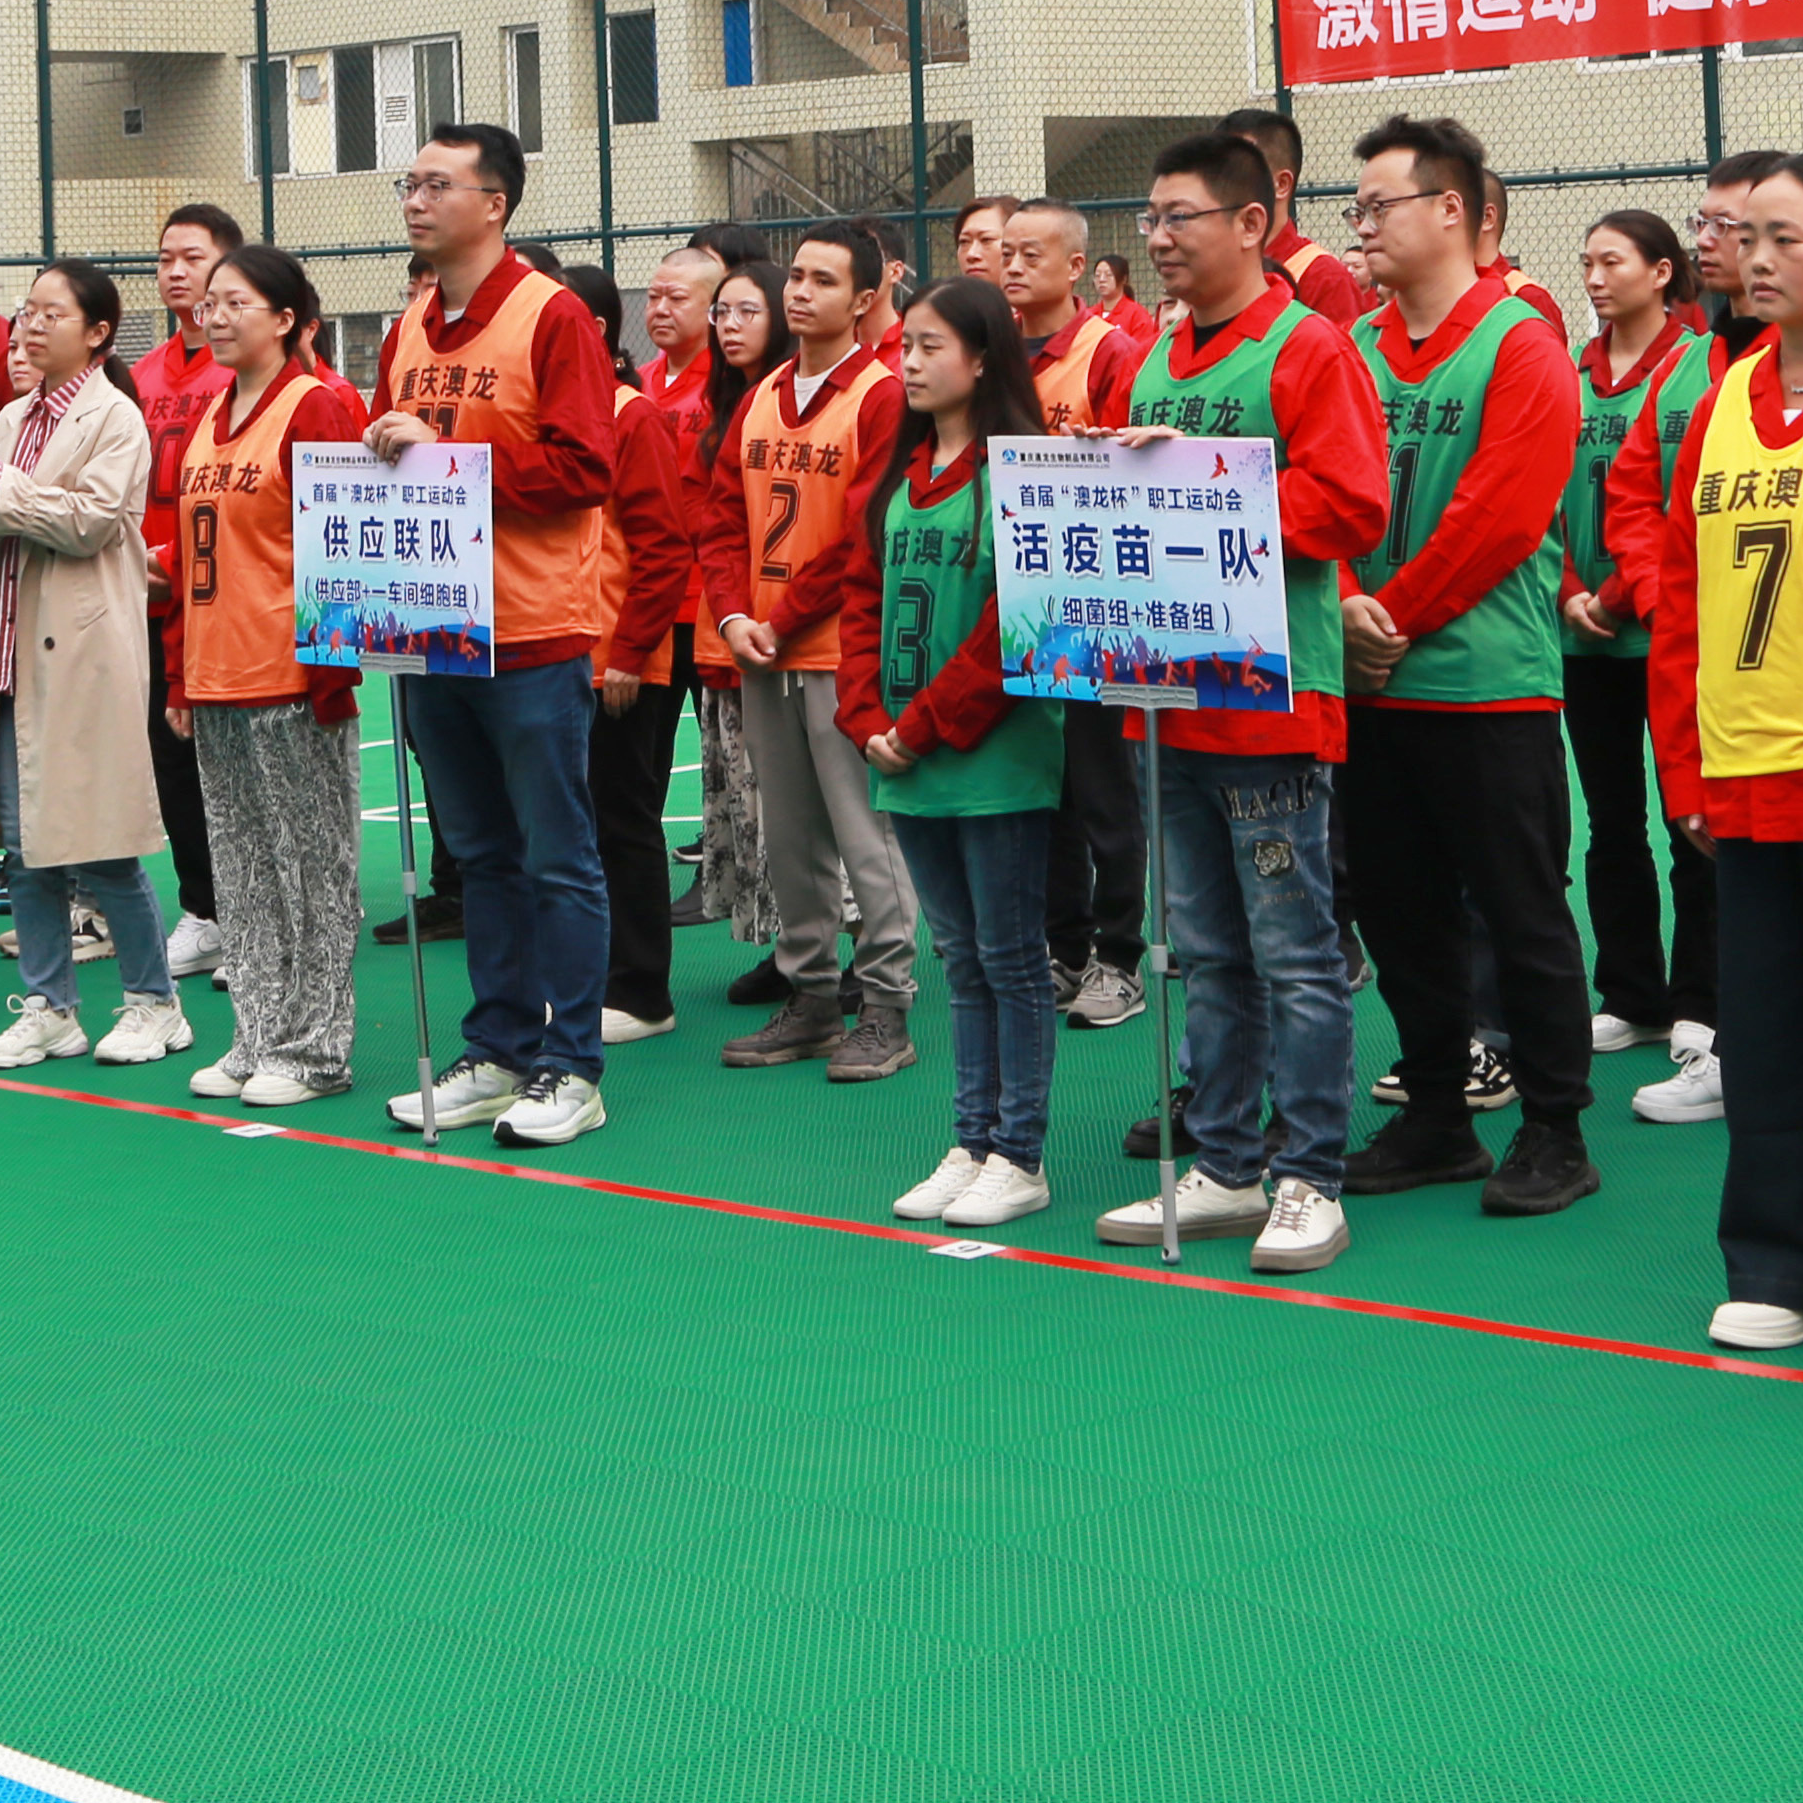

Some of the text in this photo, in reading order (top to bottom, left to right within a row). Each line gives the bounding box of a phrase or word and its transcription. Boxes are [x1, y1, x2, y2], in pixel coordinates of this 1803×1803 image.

[398, 363, 499, 403] 重庆澳龙
[180, 460, 262, 497] 重庆澳龙
[746, 438, 843, 477] 重庆澳龙
[313, 484, 467, 506] 首届“澳龙杯”职工运动会
[1019, 484, 1242, 511] 首届“澳龙杯”职工运动会
[190, 500, 219, 606] 8
[323, 515, 457, 562] 供应联队
[759, 477, 801, 584] 2
[1012, 522, 1259, 580] 活疫苗一队
[1733, 519, 1792, 671] 7
[890, 577, 936, 704] 3
